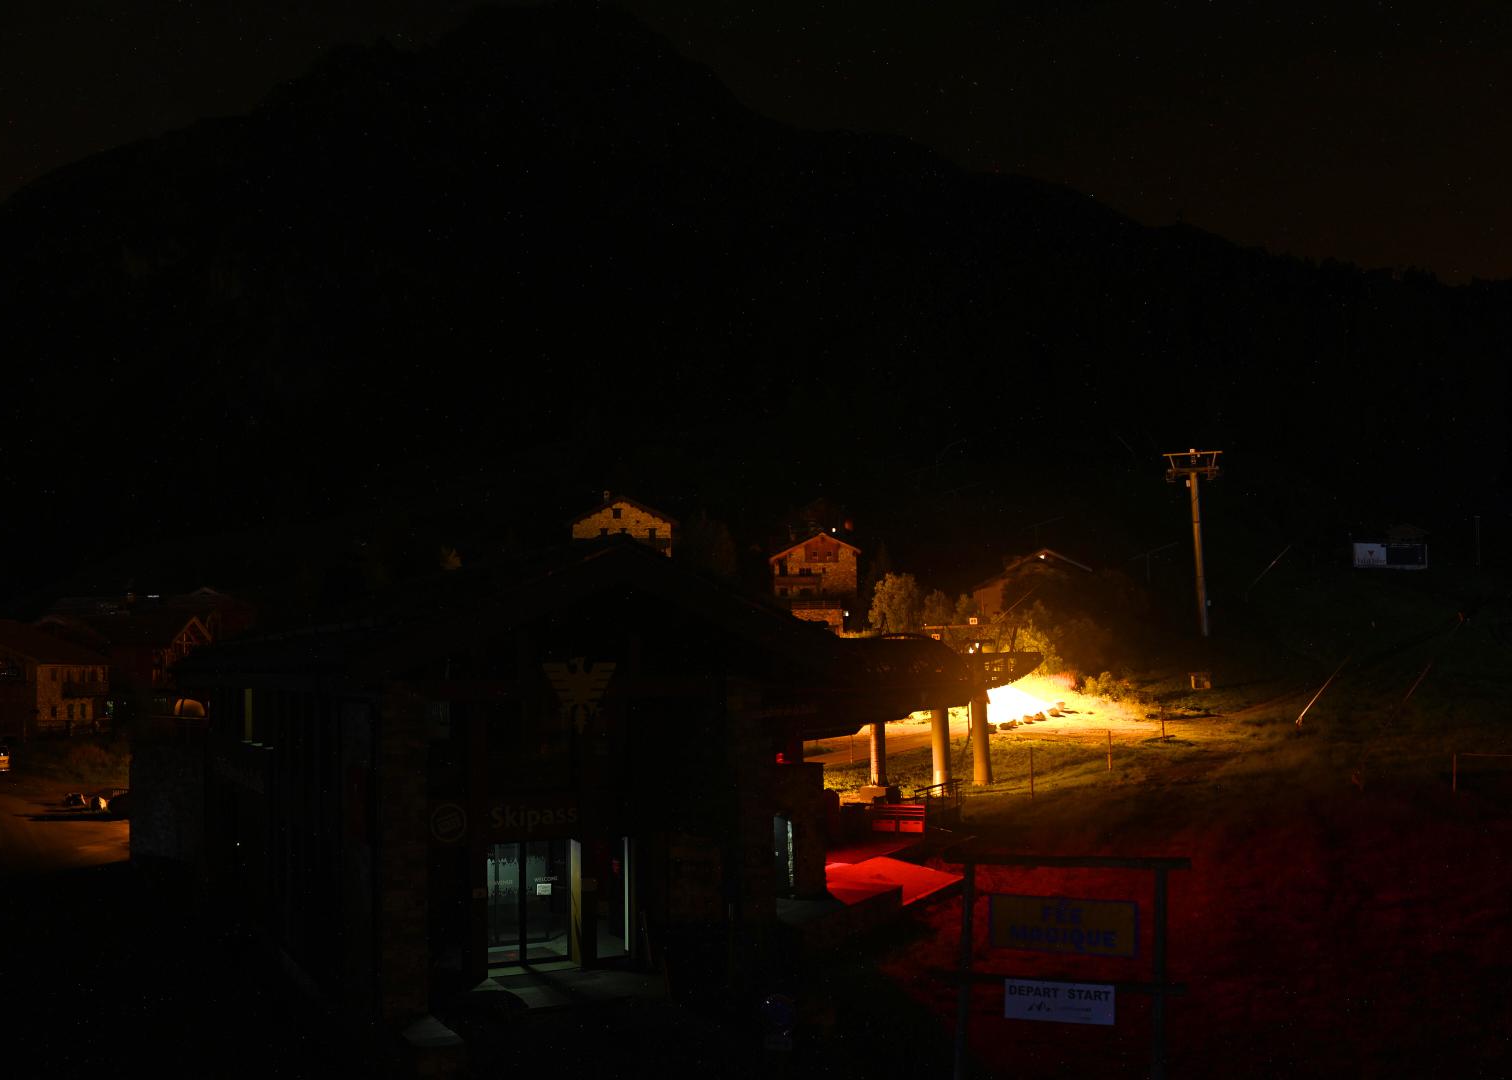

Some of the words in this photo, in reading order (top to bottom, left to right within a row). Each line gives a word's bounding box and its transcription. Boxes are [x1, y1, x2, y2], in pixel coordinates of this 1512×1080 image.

[490, 803, 577, 833] Skipass
[1010, 923, 1118, 953] MAGIQUE
[1008, 985, 1059, 999] DEPART
[1067, 988, 1111, 1002] START
